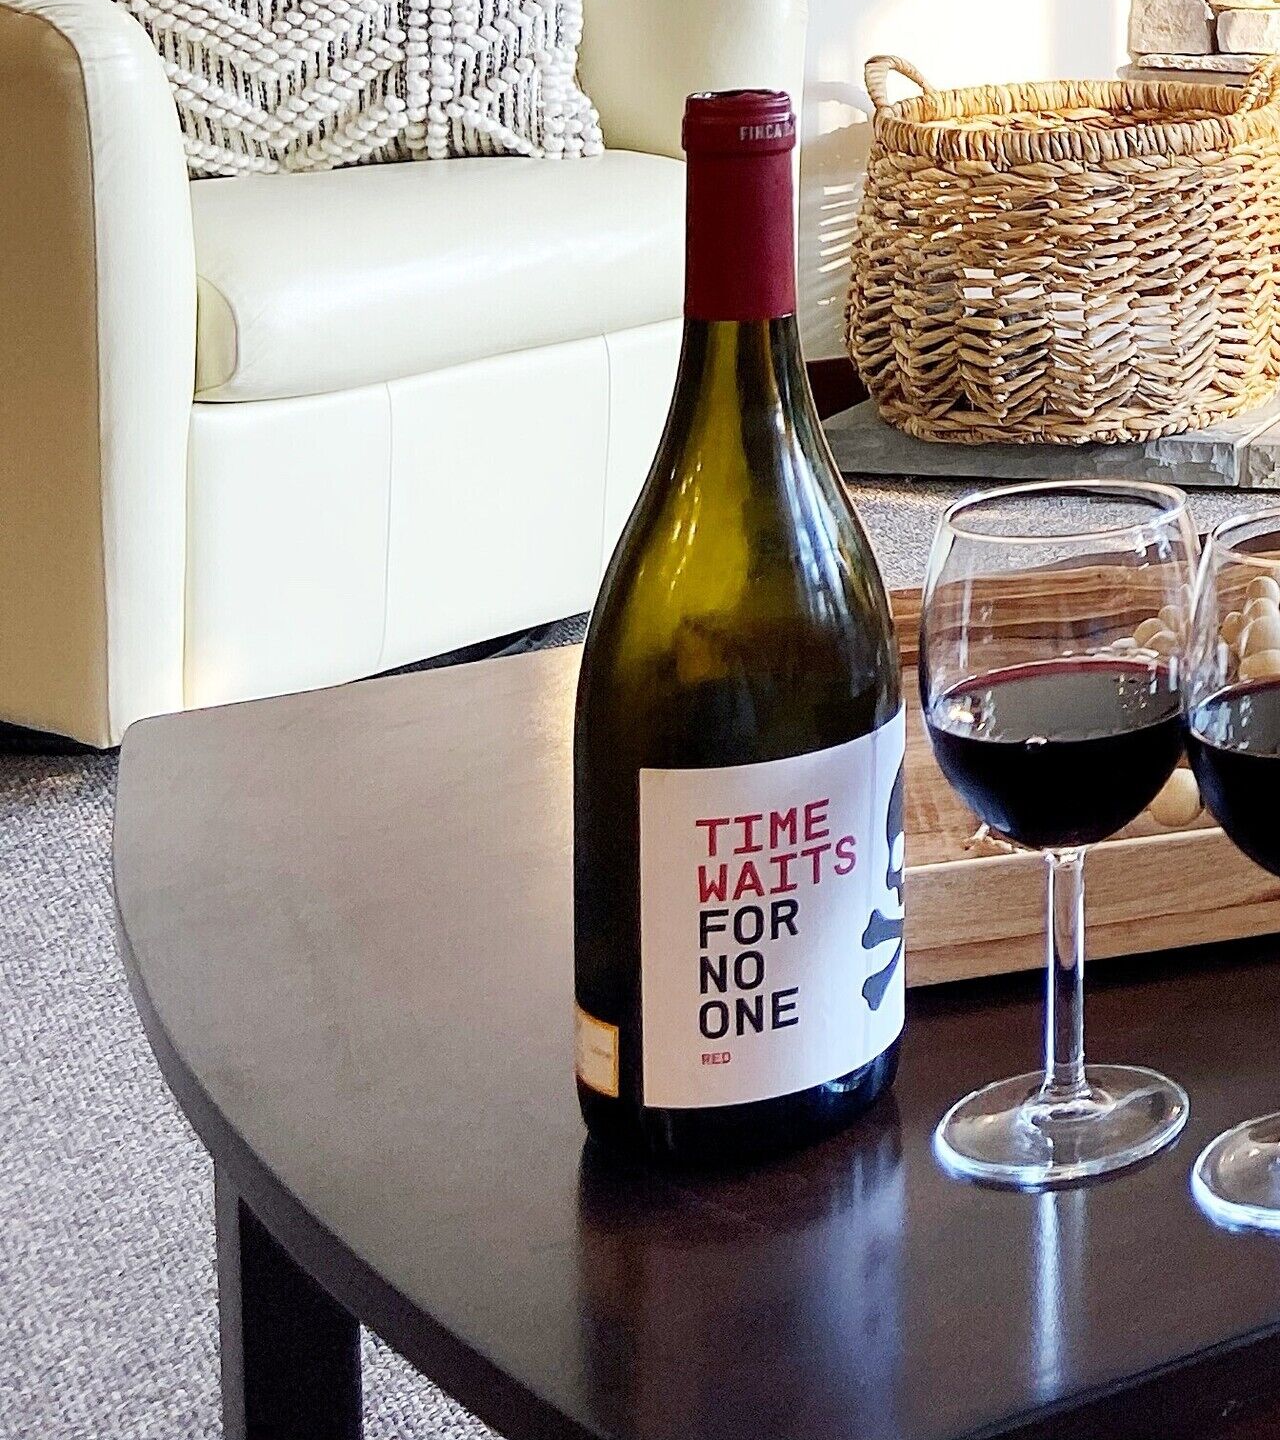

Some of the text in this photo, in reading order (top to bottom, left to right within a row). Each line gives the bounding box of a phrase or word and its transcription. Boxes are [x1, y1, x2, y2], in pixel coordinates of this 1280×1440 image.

[740, 123, 782, 140] FINCA
[695, 798, 830, 856] TIME
[697, 835, 857, 903] WAITS
[699, 898, 799, 949] FOR
[699, 950, 765, 994] NO
[698, 986, 799, 1040] ONE
[701, 1052, 731, 1065] RED
